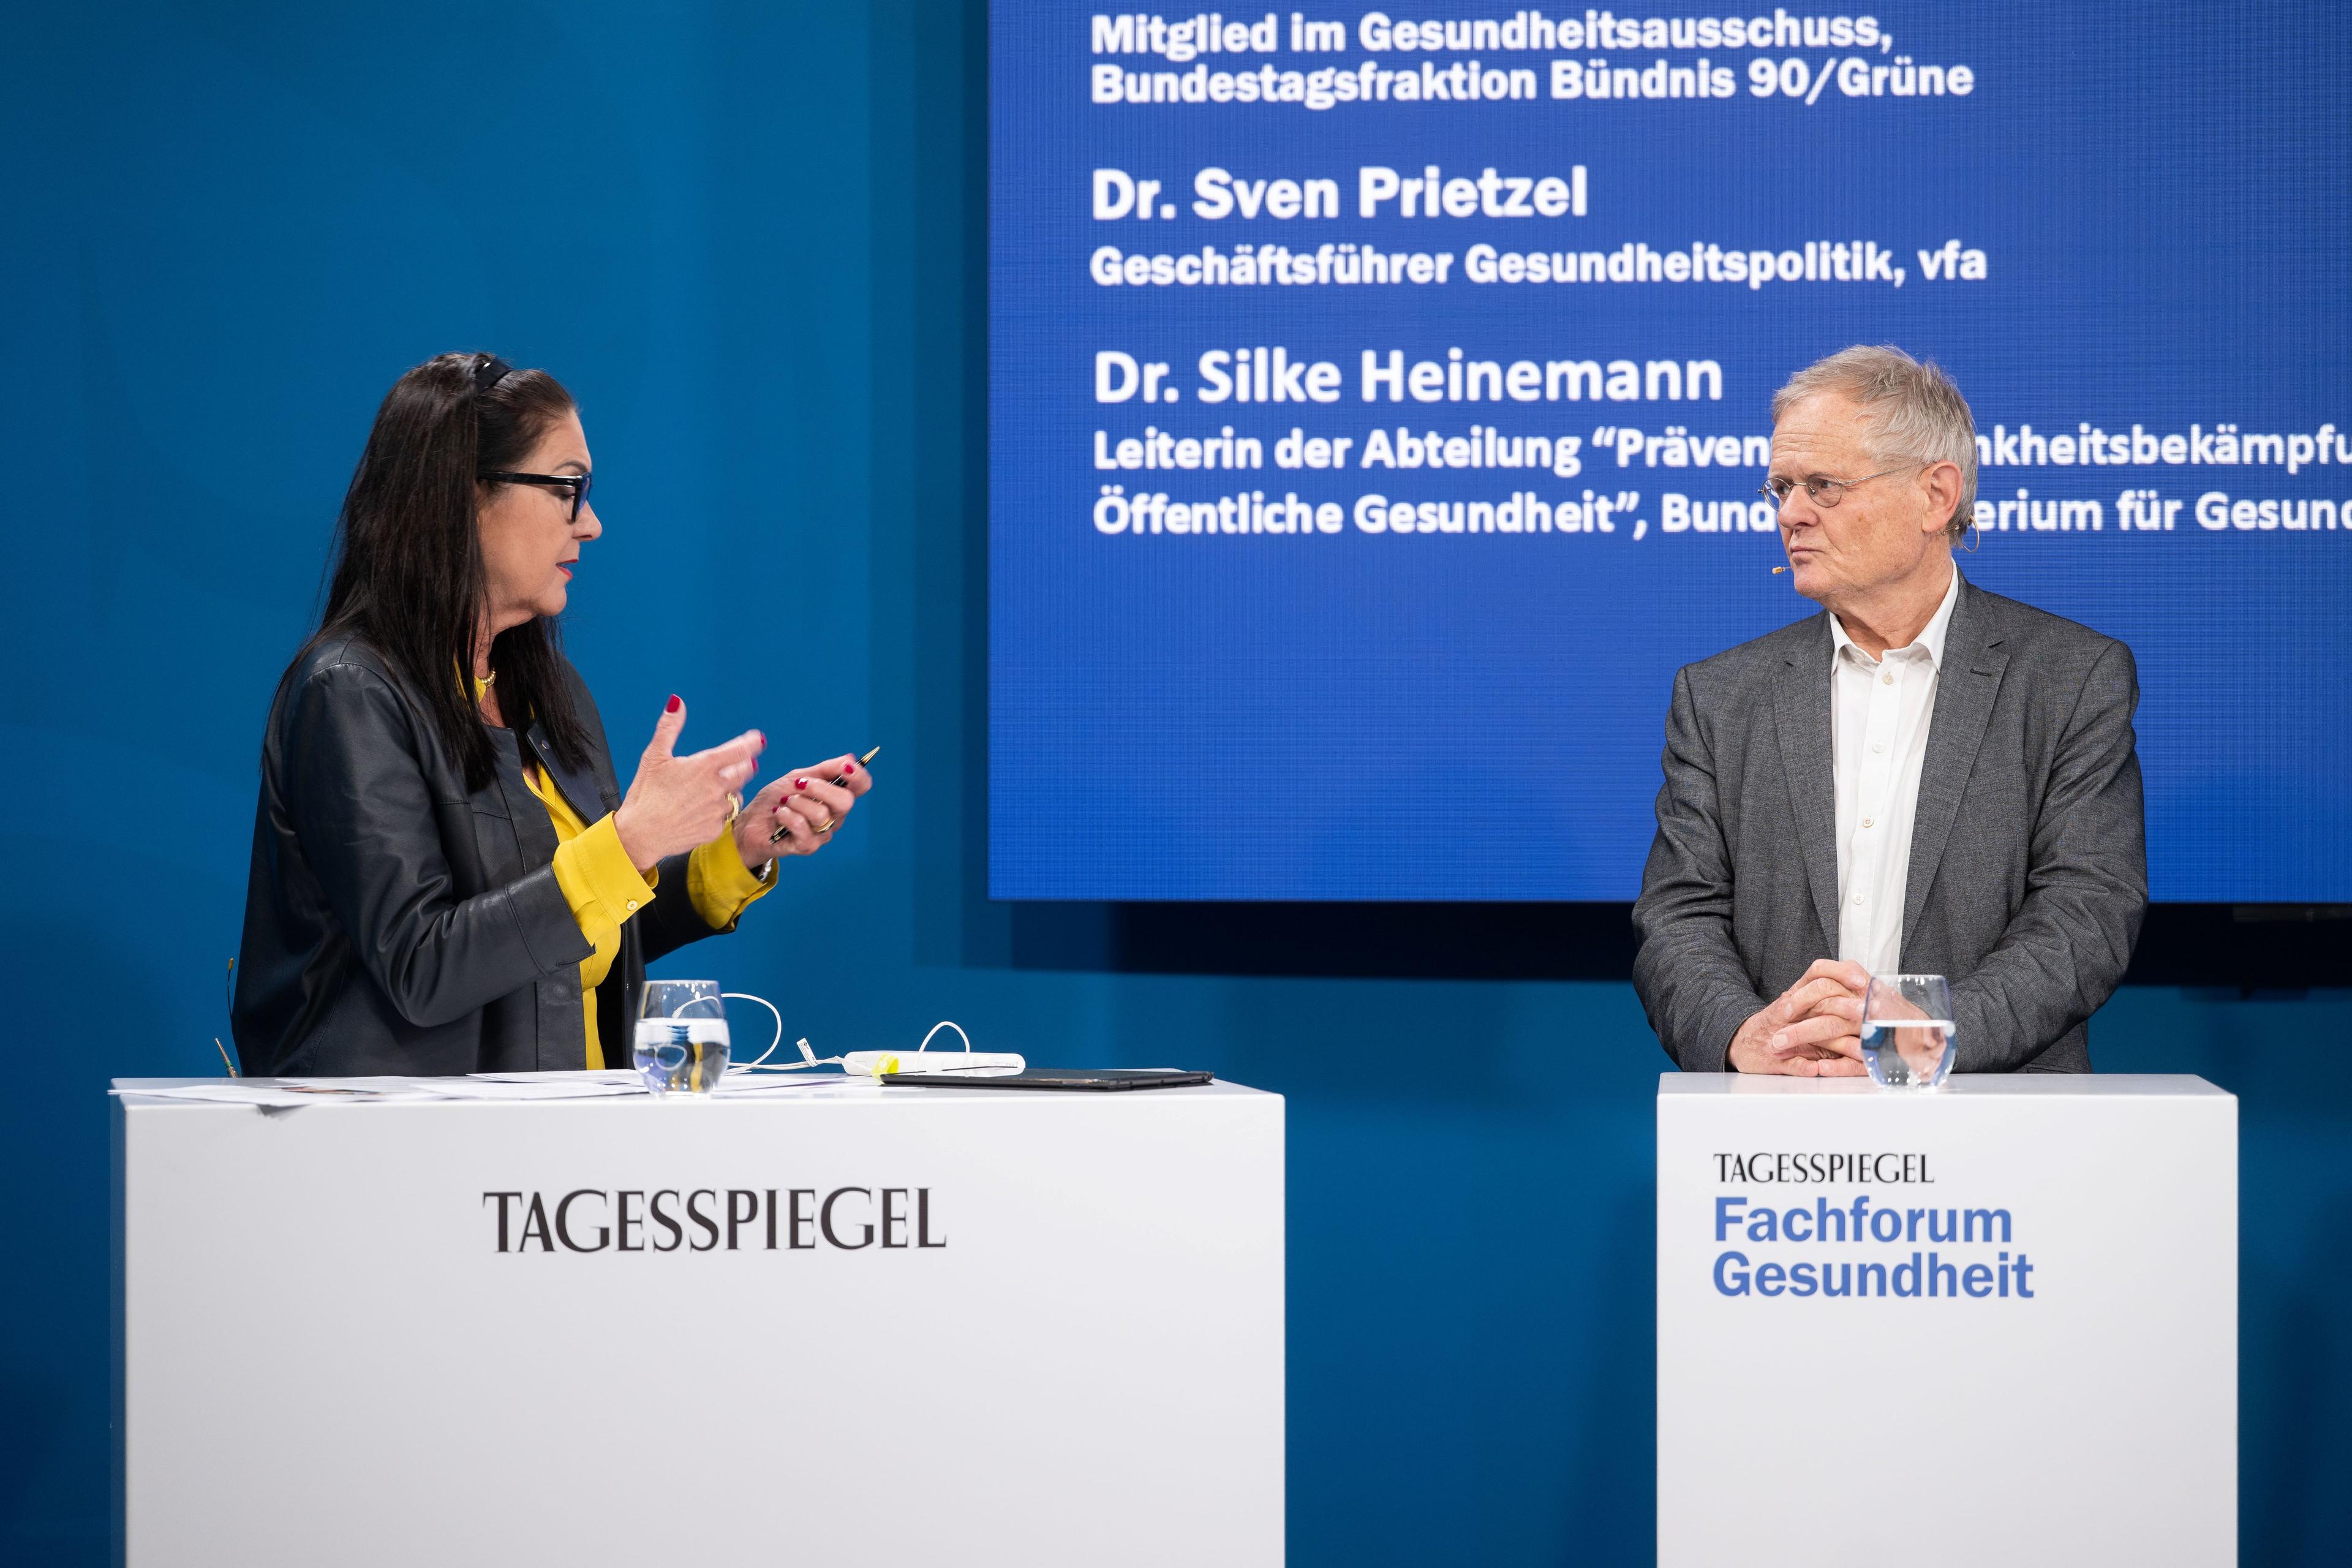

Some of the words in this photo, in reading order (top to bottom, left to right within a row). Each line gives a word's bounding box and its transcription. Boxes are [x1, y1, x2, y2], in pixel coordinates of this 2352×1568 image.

[1092, 12, 1277, 62] Mitglied
[1291, 12, 1346, 52] im
[1359, 8, 1893, 53] Gesundheitsausschuss,
[1092, 61, 1537, 110] Bundestagsfraktion
[1551, 58, 1736, 99] Bündnis
[1749, 56, 1974, 105] 90/Grüne
[1093, 169, 1176, 221] Dr.
[1192, 167, 1339, 220] Sven
[1359, 165, 1587, 218] Prietzel
[1090, 244, 1453, 286] Geschäftsführer
[1464, 241, 1905, 290] Gesundheitspolitik,
[1918, 239, 1987, 281] vfa
[1095, 351, 1179, 403] Dr.
[1198, 346, 1341, 404] Silke
[1362, 347, 1722, 402] Heinemann
[1095, 426, 1263, 470] Leiterin
[1275, 427, 1353, 469] der
[1361, 425, 1581, 478] Abteilung
[1592, 426, 1771, 467] “Präven
[1093, 484, 1344, 535] Öffentliche
[1353, 489, 1648, 541] Gesundheit”,
[2116, 489, 2183, 530] für
[1714, 1153, 1934, 1183] TAGESSPIEGEL
[483, 1187, 946, 1253] TAGESSPIEGEL
[1715, 1196, 2011, 1242] Fachforum
[1713, 1251, 2034, 1298] Gesundheit
